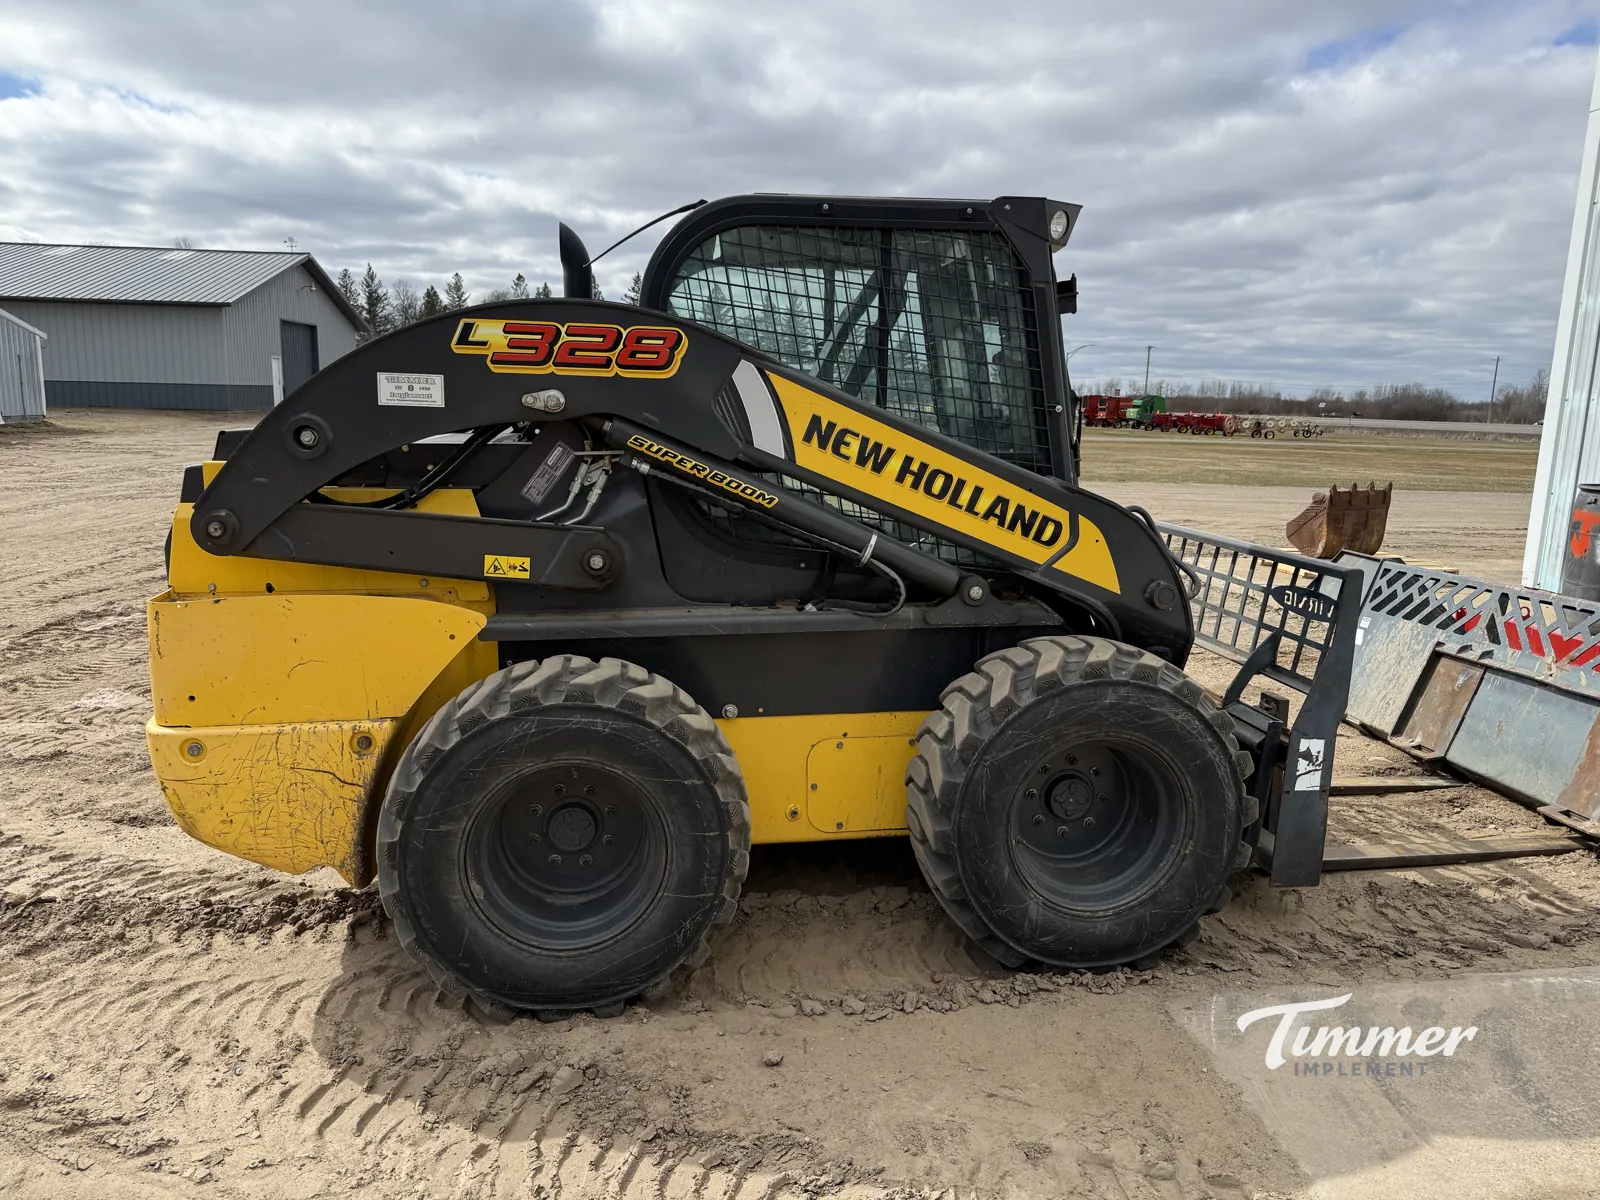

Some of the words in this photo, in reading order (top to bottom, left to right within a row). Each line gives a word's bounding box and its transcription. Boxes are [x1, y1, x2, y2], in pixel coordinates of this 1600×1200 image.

[452, 319, 687, 376] L328
[628, 436, 709, 478] SUPER
[707, 470, 778, 508] BOOM
[801, 413, 896, 476] NEW
[894, 454, 1063, 548] HOLLAND
